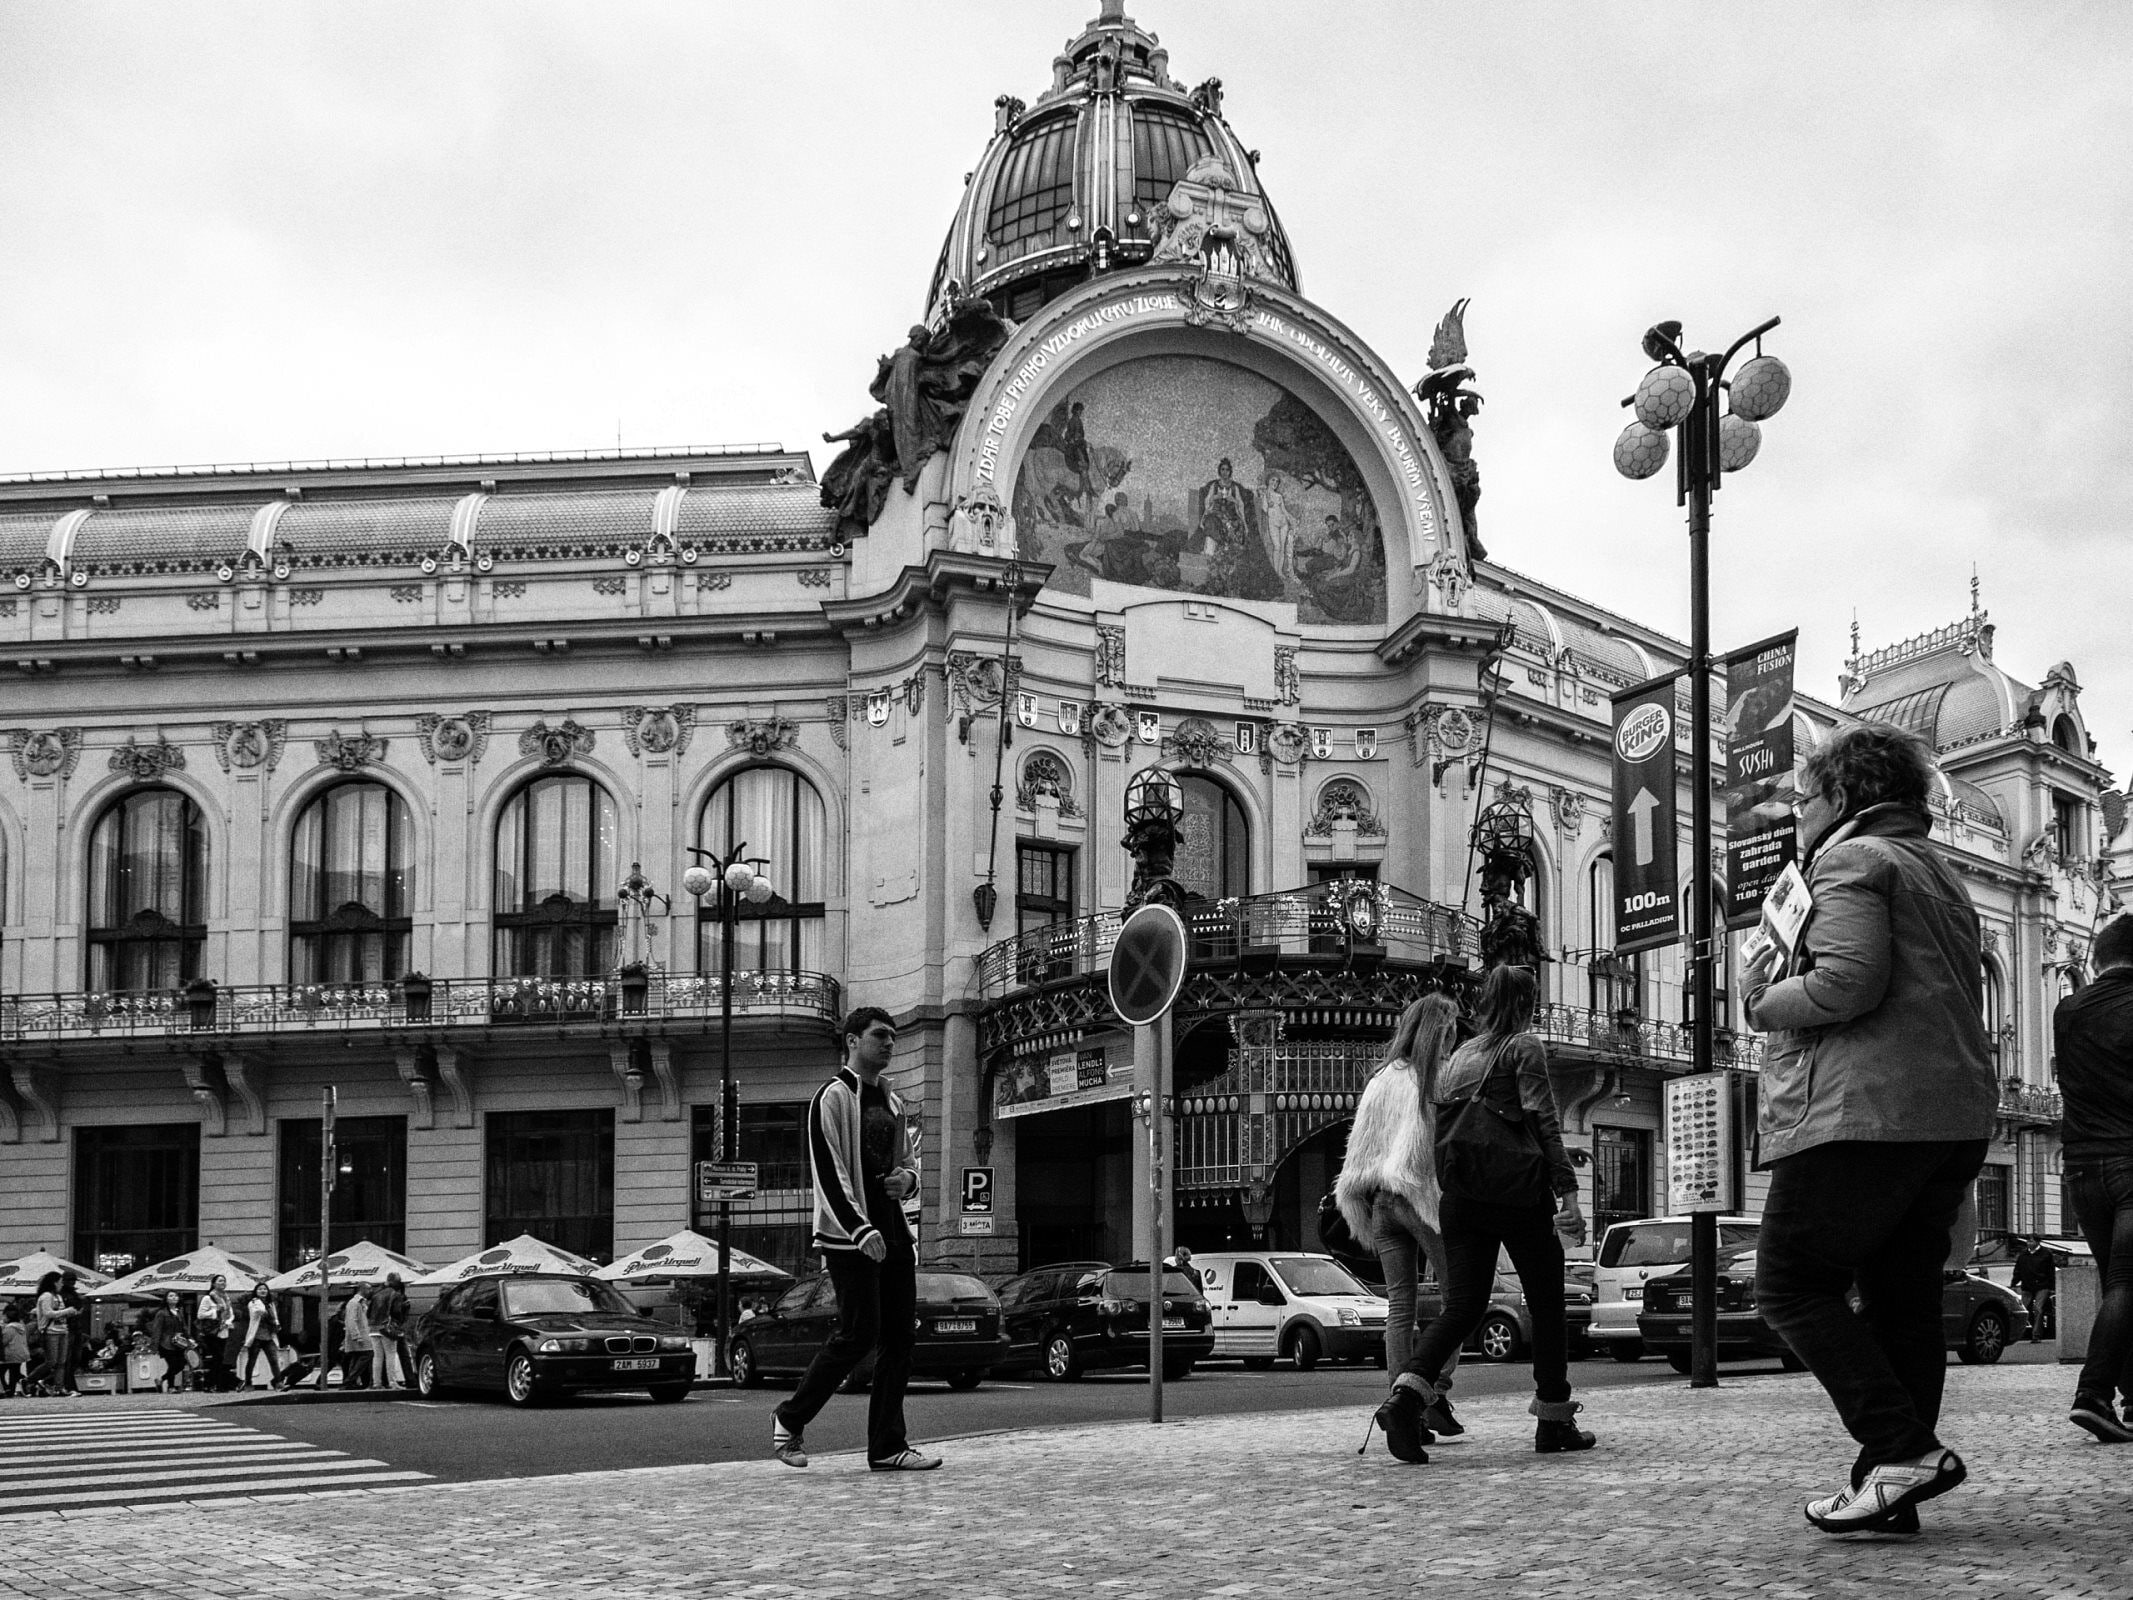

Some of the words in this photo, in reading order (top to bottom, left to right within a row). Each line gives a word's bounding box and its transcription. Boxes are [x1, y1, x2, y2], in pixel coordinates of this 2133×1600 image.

[1256, 311, 1285, 335] JAK
[977, 438, 999, 481] ZDAR
[1757, 645, 1787, 664] CHINA
[1757, 653, 1793, 676] FUSION
[1622, 709, 1663, 743] BURGER
[1624, 718, 1665, 755] KING
[1739, 748, 1774, 778] SUSHI
[1728, 831, 1772, 850] Slovanský
[1773, 825, 1795, 838] dům
[1740, 840, 1782, 859] zahrada
[1742, 853, 1781, 872] garden
[1737, 879, 1759, 891] open
[1761, 869, 1783, 884] dail
[1624, 891, 1671, 914] 100m
[1735, 889, 1758, 901] 11.00
[1620, 925, 1631, 933] OC
[1631, 914, 1674, 930] PALLADIUM
[1078, 1067, 1105, 1079] ALFONS
[1078, 1076, 1103, 1088] MUCHA
[967, 1172, 988, 1199] P
[962, 1221, 968, 1230] 3
[339, 1266, 380, 1277] Urquell
[501, 1262, 541, 1273] Urquell
[621, 1260, 665, 1276] Pilsner
[663, 1257, 702, 1268] Urquell
[637, 1359, 657, 1370] 5937
